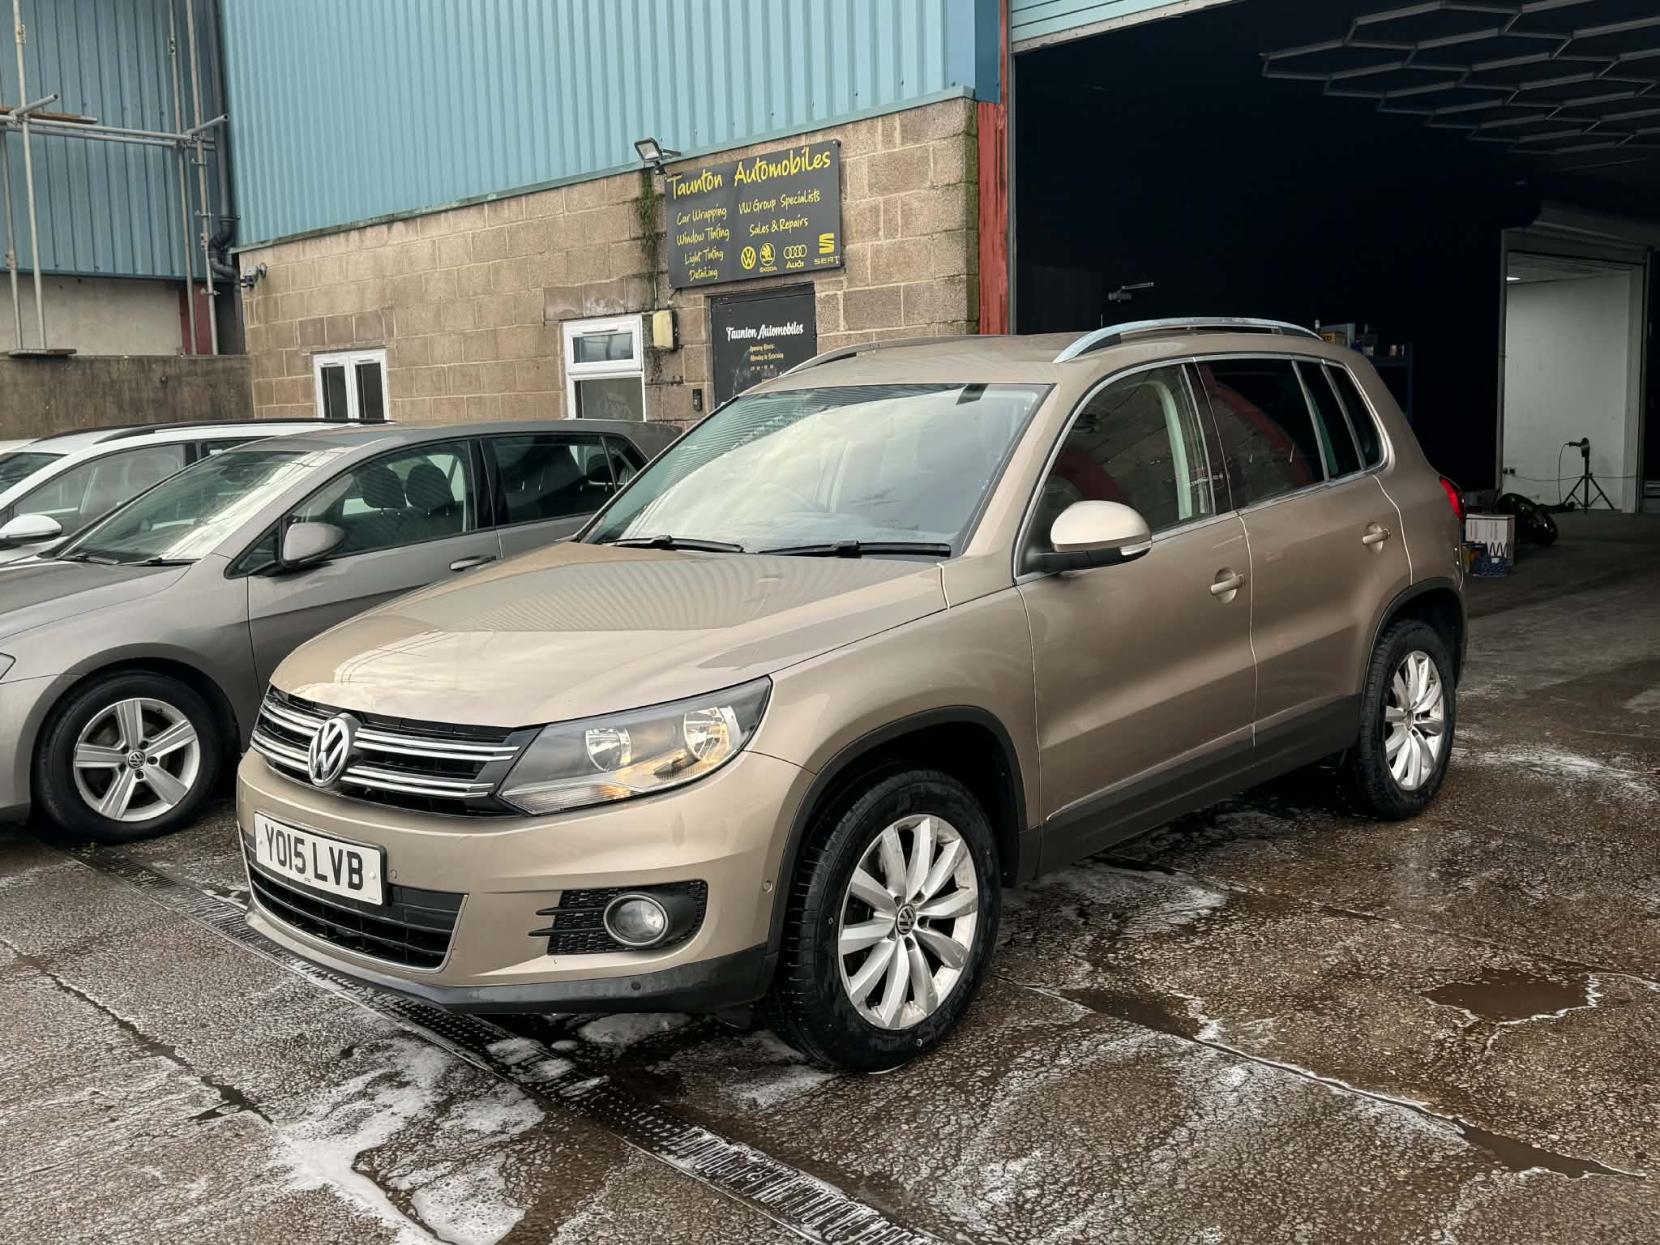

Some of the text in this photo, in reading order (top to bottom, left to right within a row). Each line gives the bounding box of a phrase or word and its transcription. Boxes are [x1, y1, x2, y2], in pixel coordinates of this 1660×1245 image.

[667, 146, 830, 200] Taunton Automobiles
[739, 189, 821, 214] VW Group Specialists
[677, 205, 727, 225] Car Wrapping
[677, 223, 730, 246] Window Tinting
[750, 214, 808, 237] Sales & Repairs
[684, 251, 702, 266] Light
[786, 260, 804, 268] Audi
[814, 256, 840, 265] SEAT
[689, 267, 718, 281] Detailing
[726, 321, 804, 341] Taunton Automobiles
